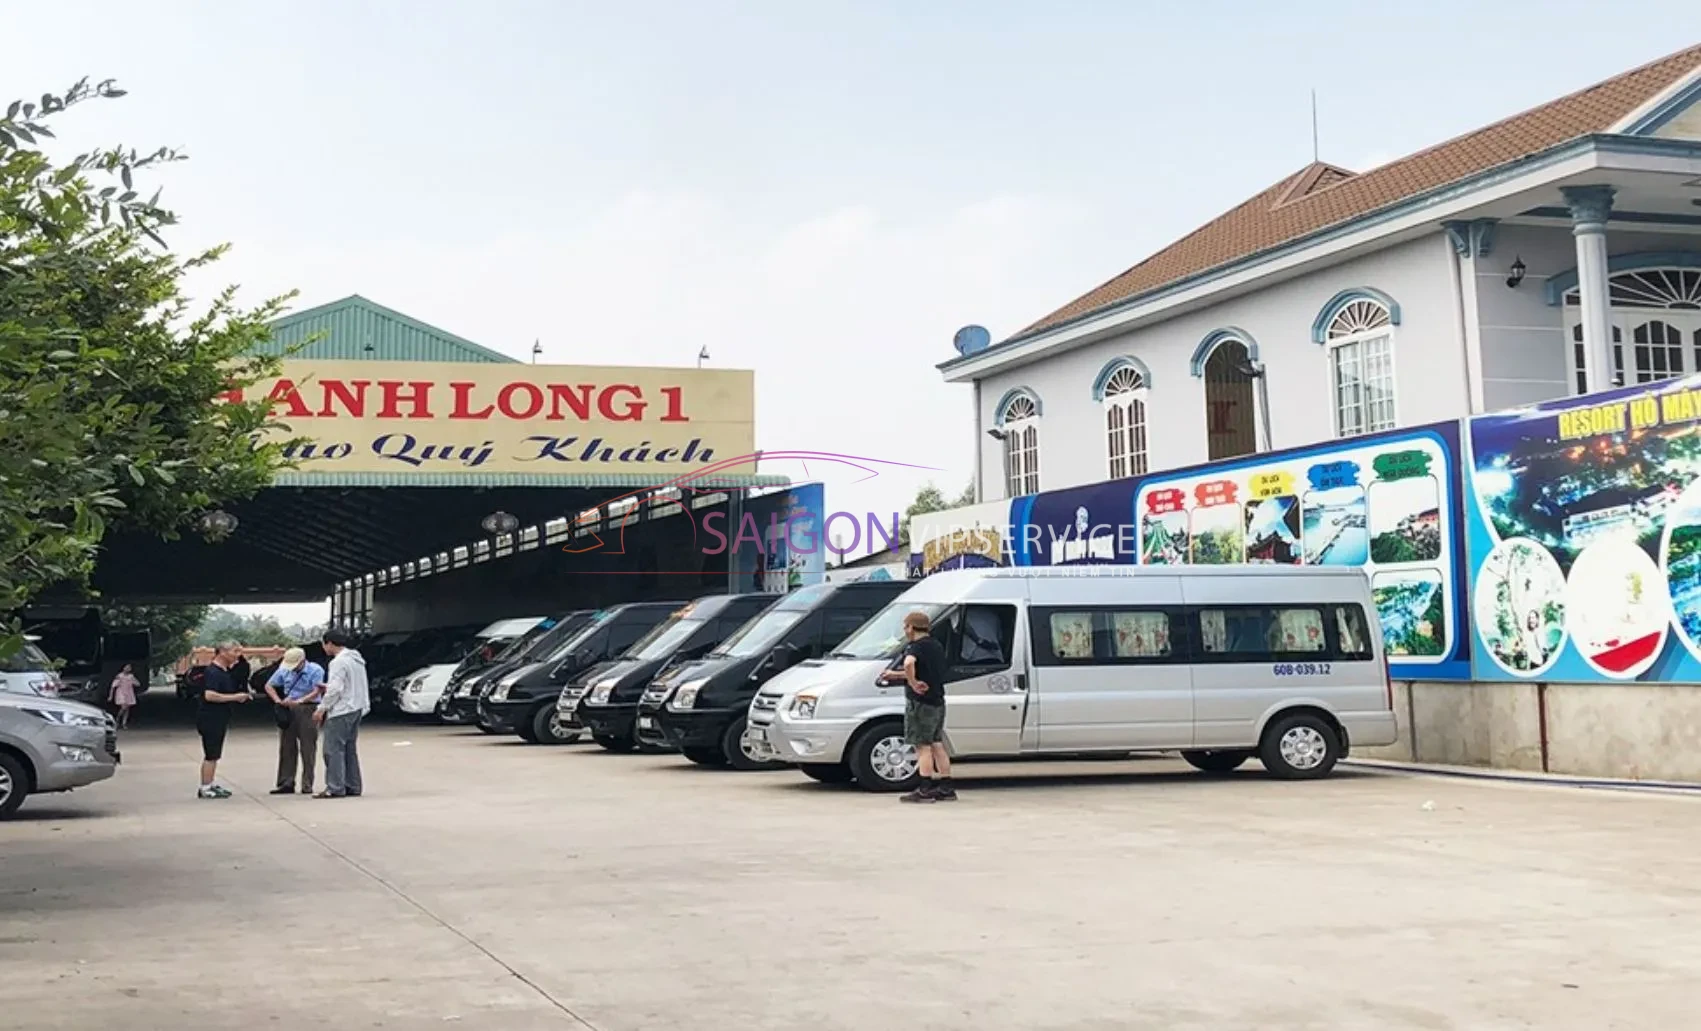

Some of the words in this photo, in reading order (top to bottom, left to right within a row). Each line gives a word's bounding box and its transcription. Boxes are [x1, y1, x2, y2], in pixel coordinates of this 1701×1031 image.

[448, 381, 649, 421] LONG
[660, 386, 690, 422] 1
[1558, 402, 1628, 441] RESORT
[512, 435, 718, 463] Khách
